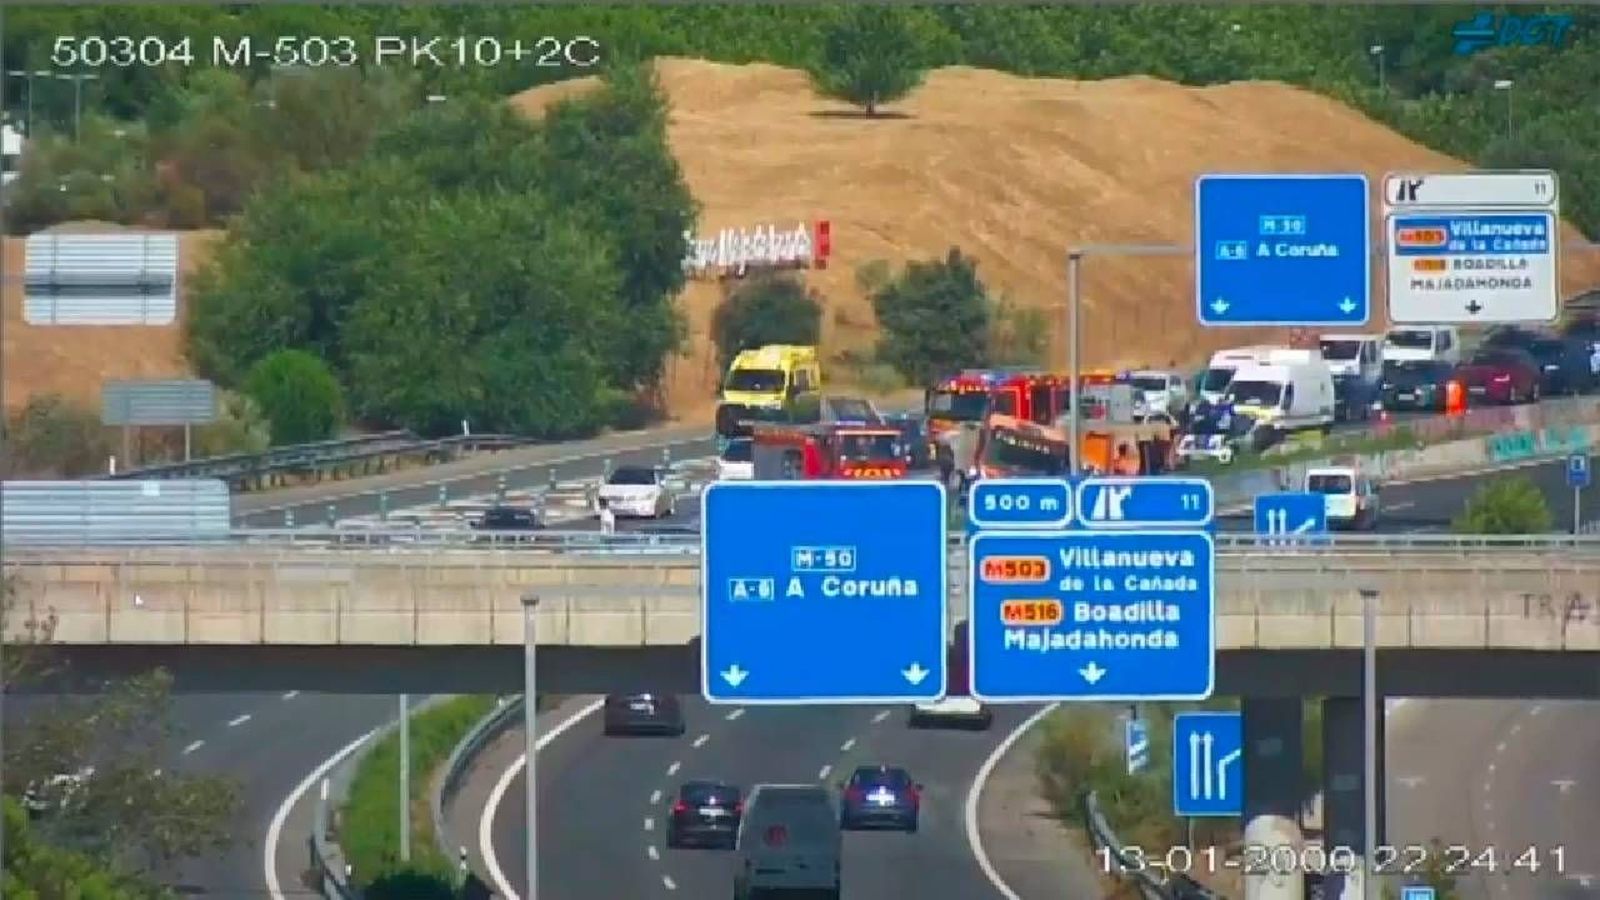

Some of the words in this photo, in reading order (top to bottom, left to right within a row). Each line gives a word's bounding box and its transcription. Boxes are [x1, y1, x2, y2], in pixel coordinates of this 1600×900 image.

[1450, 220, 1545, 236] Villanueva
[1257, 242, 1270, 257] A
[984, 494, 1030, 511] 500
[1040, 497, 1060, 511] m
[1181, 494, 1200, 510] 11
[796, 549, 852, 567] M-50
[1059, 548, 1195, 568] Villanueva
[984, 560, 1047, 578] M503
[786, 577, 805, 597] A
[822, 576, 917, 597] Coruña
[1059, 575, 1085, 591] de
[1094, 575, 1115, 591] la
[1124, 574, 1198, 591] Cañada
[1004, 604, 1058, 621] M516
[1074, 601, 1180, 622] Boadilla
[1004, 630, 1180, 653] Majadahonda
